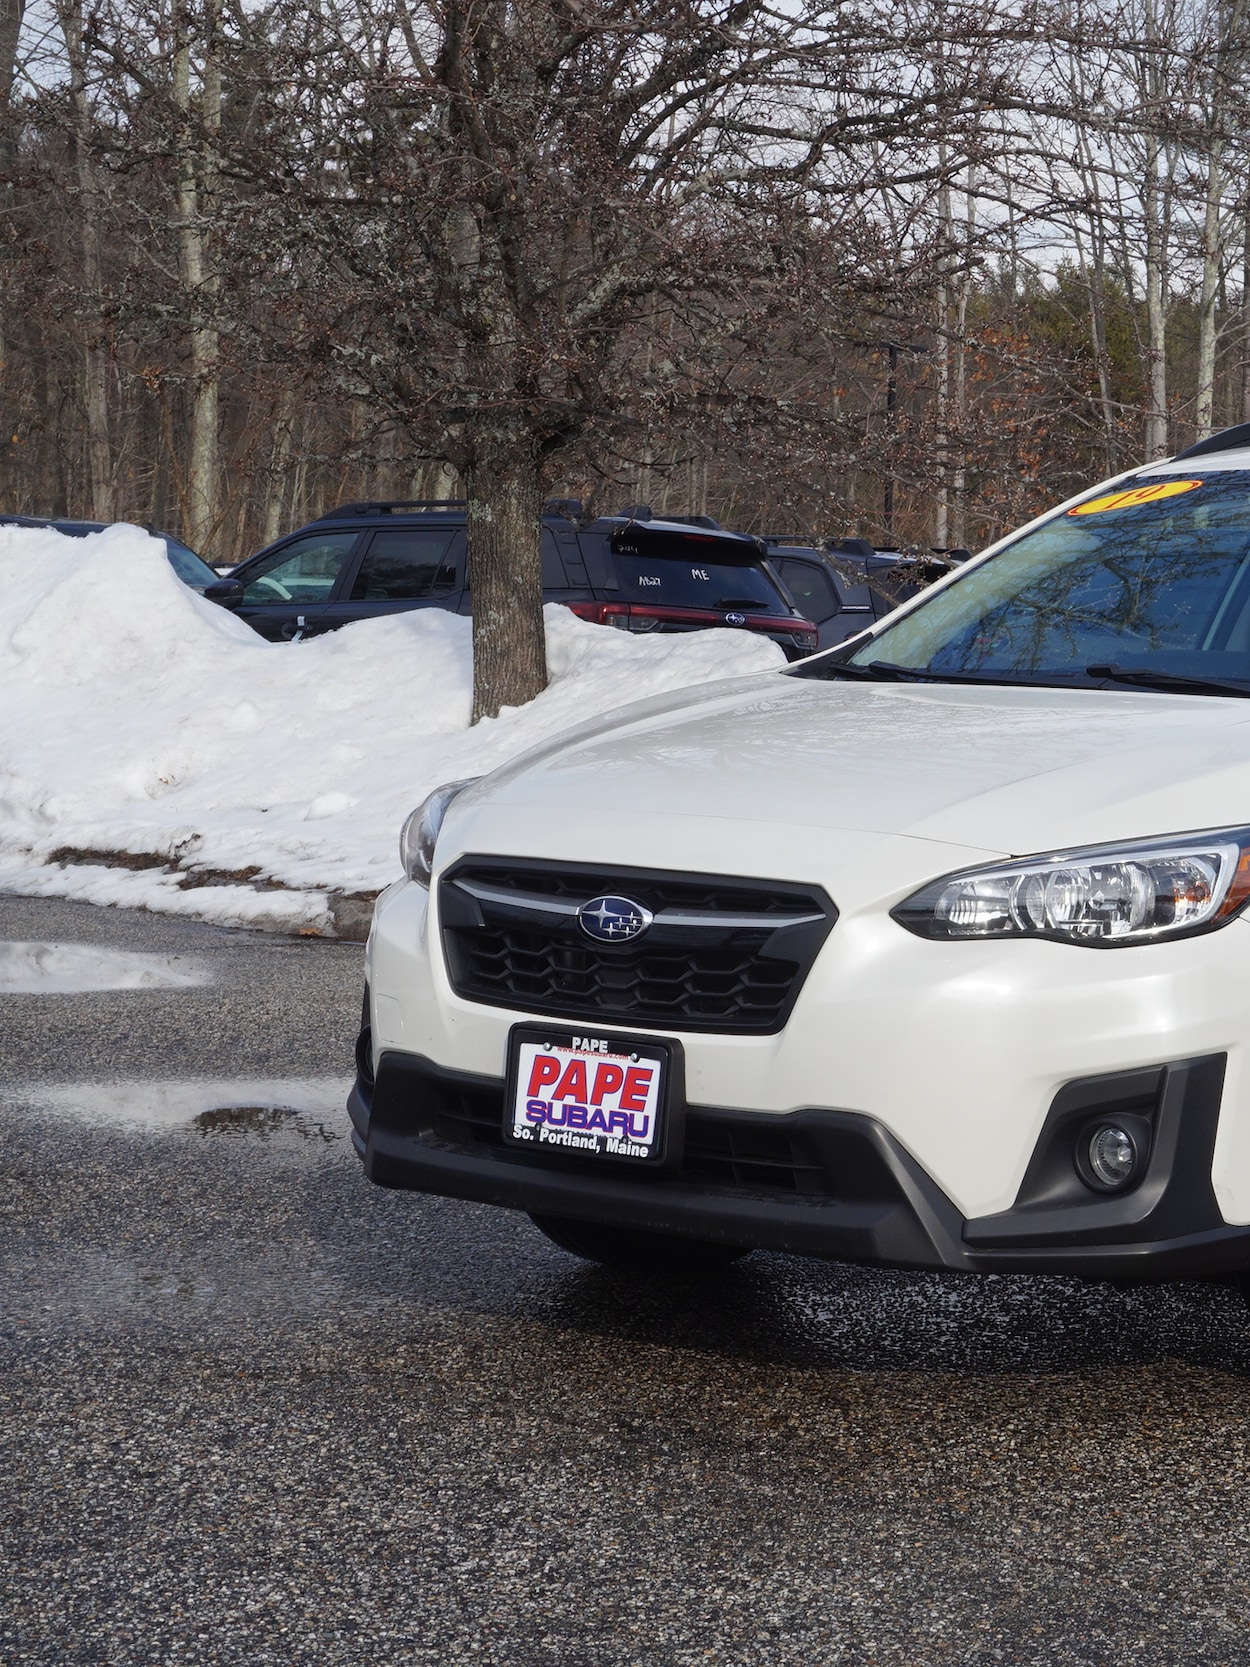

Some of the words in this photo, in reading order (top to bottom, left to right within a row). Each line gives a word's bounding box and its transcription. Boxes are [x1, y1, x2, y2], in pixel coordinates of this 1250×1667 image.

[691, 568, 710, 581] ME
[572, 1036, 609, 1053] PAPE
[526, 1054, 653, 1112] PAPE
[526, 1099, 650, 1138] SUBARU
[512, 1124, 534, 1141] So.
[539, 1127, 601, 1154] Portland,
[606, 1136, 649, 1158] Maine
